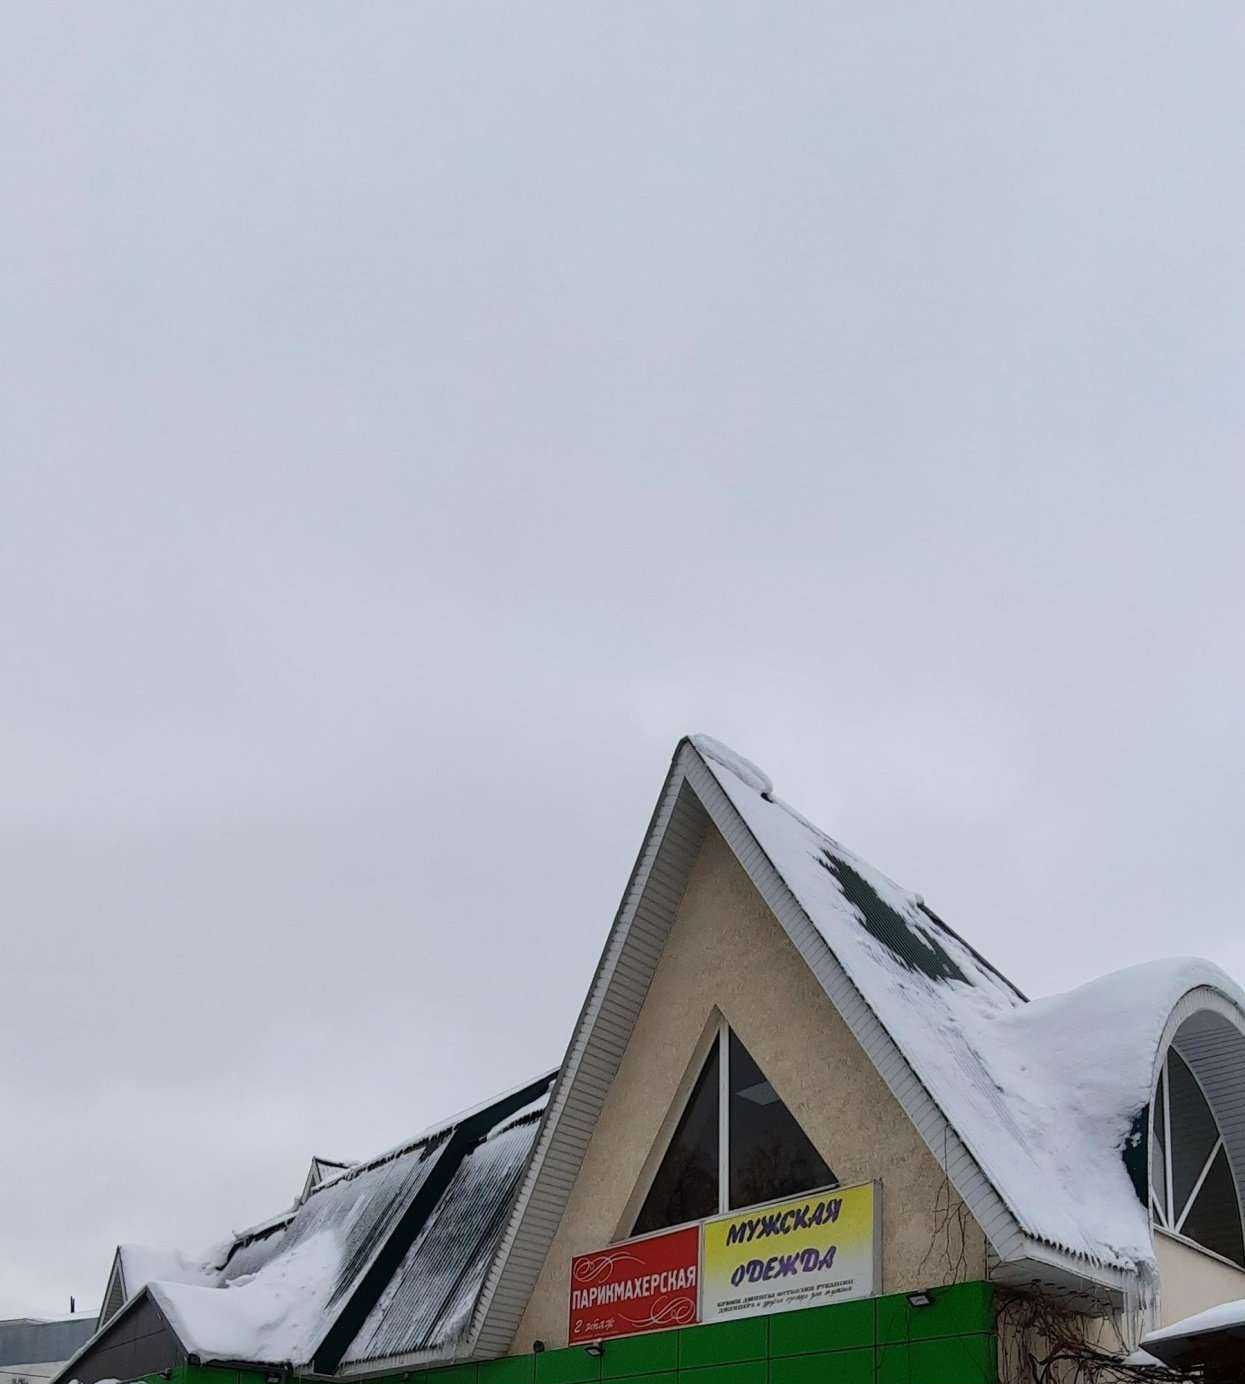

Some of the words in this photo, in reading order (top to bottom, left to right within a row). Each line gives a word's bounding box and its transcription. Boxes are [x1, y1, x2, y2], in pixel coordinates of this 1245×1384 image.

[726, 1198, 843, 1246] МУЖСКАЯ
[572, 1265, 697, 1310] ПАРИКМАХЕРСКАЯ
[731, 1245, 837, 1287] ОДЕЖДА
[574, 1319, 584, 1333] 2
[585, 1317, 616, 1332] этаж
